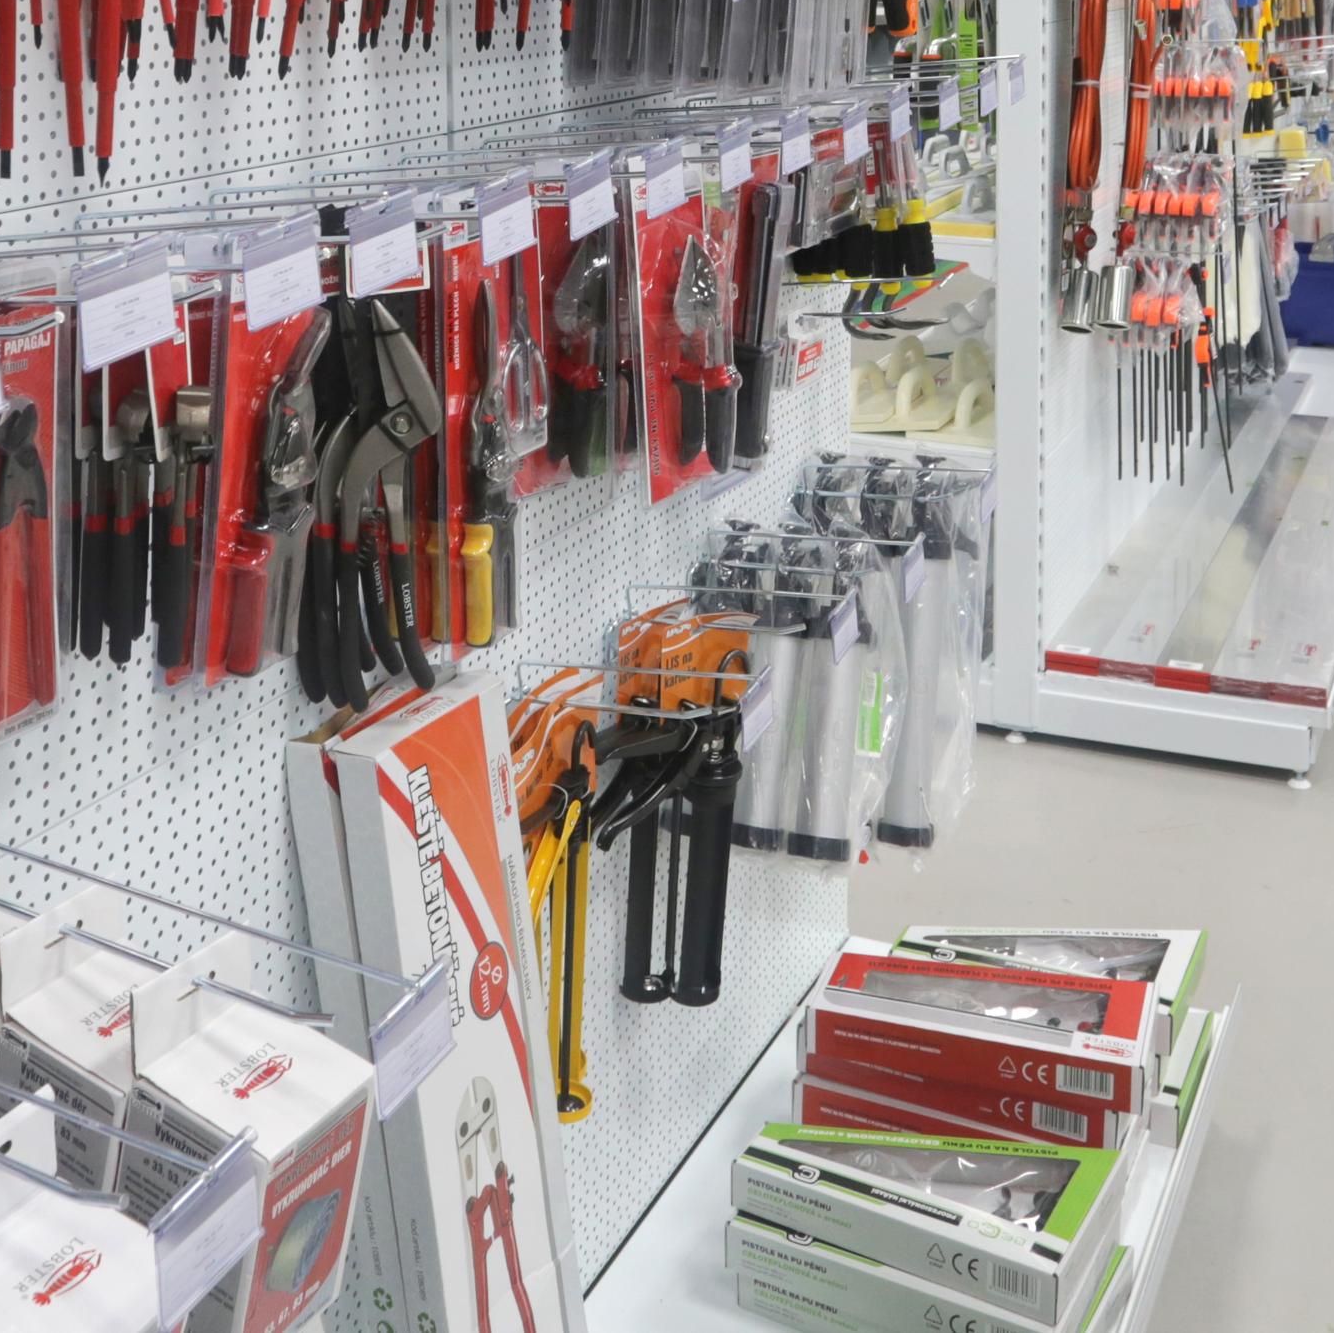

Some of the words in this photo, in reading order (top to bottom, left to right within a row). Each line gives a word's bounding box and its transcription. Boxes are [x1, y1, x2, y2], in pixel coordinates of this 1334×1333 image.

[401, 582, 415, 628] LOBSTER
[478, 955, 491, 981] 12
[479, 981, 490, 1014] mm
[216, 1042, 276, 1089] LOBSTER
[1012, 1145, 1058, 1157] PISTOLE
[747, 1177, 781, 1198] PISTOLE
[782, 1188, 795, 1200] NA
[796, 1192, 808, 1205] PU
[13, 1237, 85, 1294] LOBSTER
[742, 1239, 776, 1260] PISTOLE
[777, 1250, 790, 1262] NA
[791, 1254, 803, 1267] PU
